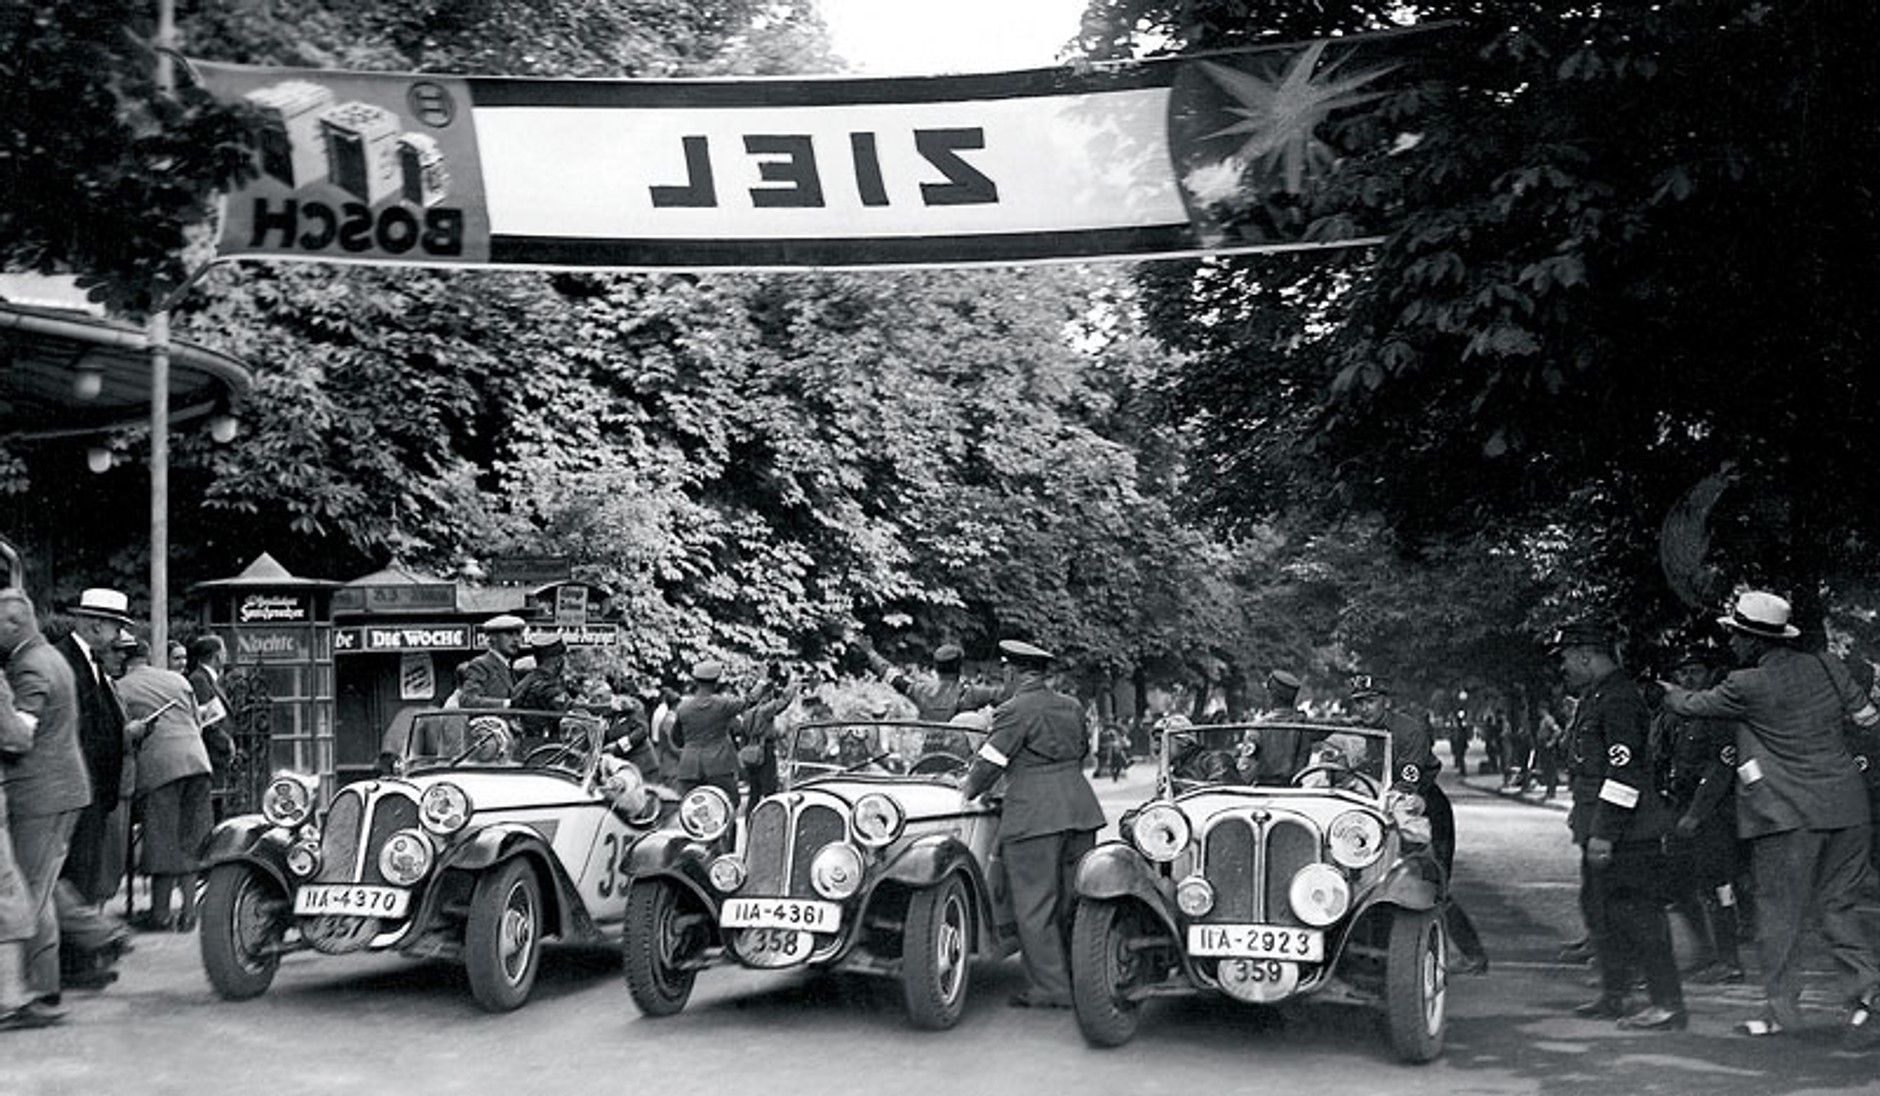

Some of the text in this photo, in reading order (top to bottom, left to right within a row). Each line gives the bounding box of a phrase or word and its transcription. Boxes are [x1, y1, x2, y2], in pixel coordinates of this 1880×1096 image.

[371, 630, 400, 648] DIE
[401, 629, 463, 647] WOCHE
[305, 889, 397, 912] IIA-4370
[735, 903, 825, 925] IIA-4361
[754, 929, 799, 956] 358
[1200, 928, 1311, 956] IIA-2923
[1233, 957, 1283, 983] 359
